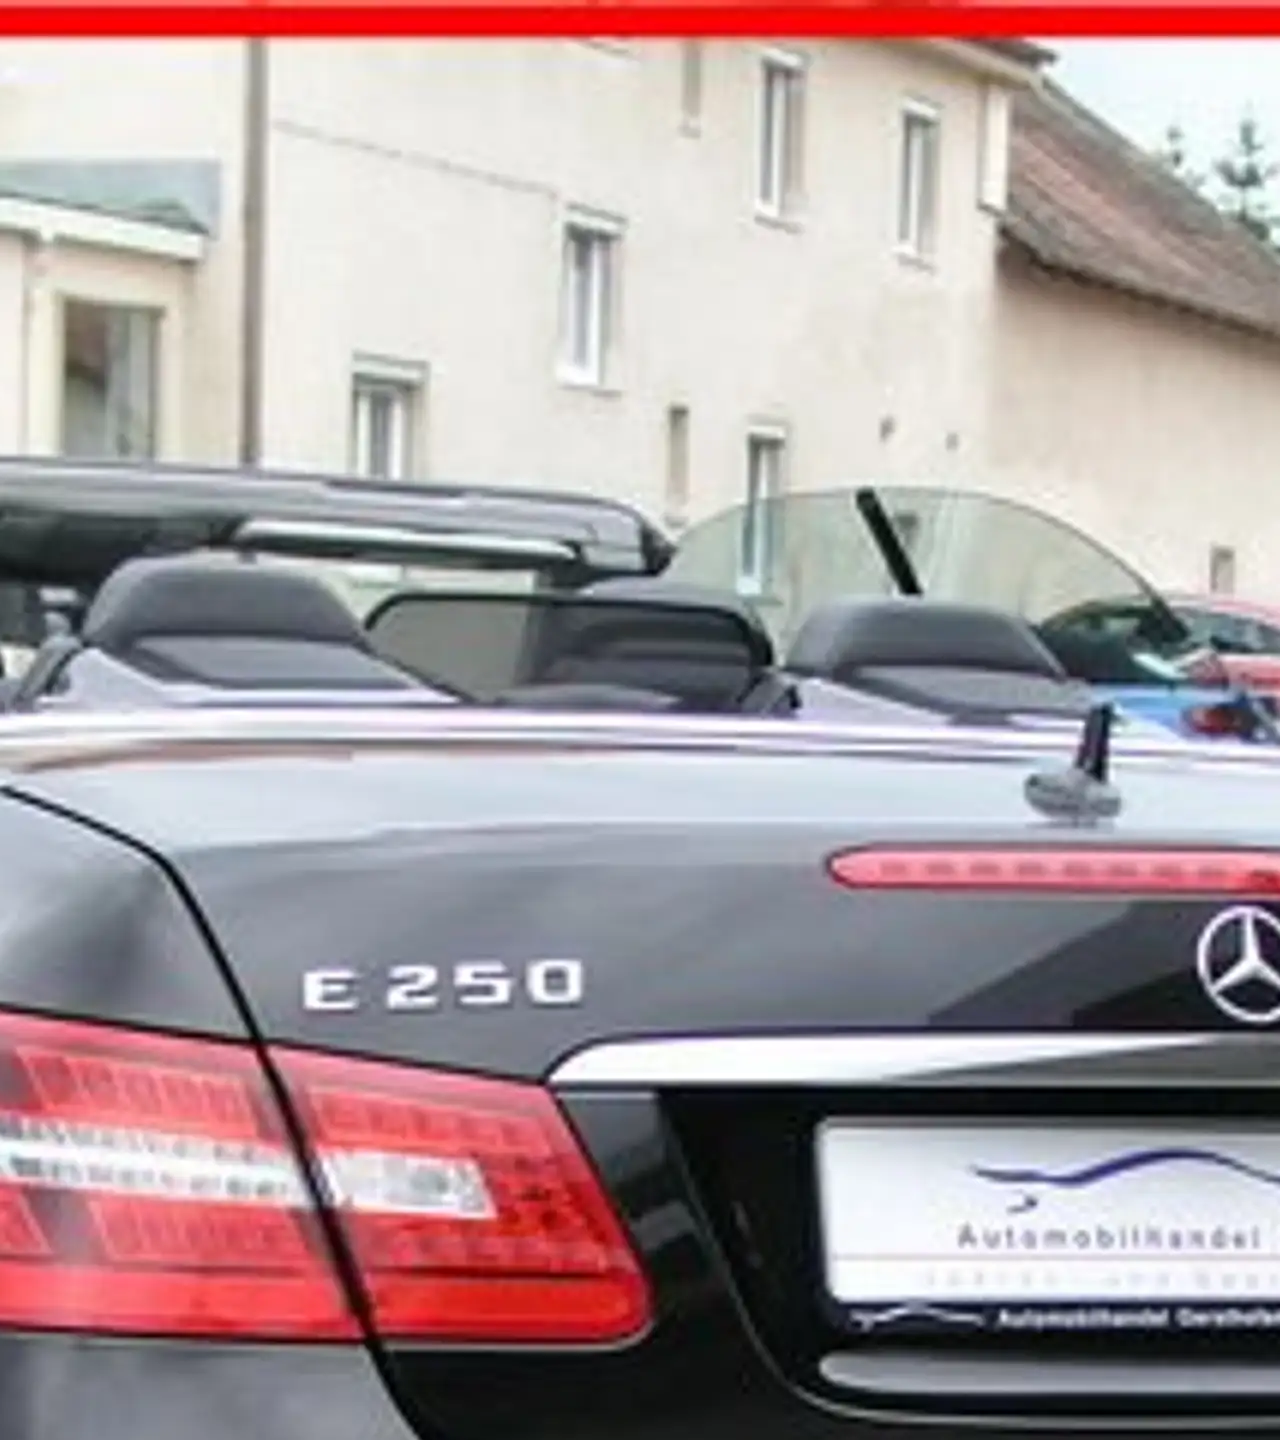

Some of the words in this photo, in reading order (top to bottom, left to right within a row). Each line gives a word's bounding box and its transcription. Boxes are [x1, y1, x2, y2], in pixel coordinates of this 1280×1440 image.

[302, 967, 359, 1011] E
[385, 958, 586, 1009] 250
[956, 1221, 1262, 1250] Automobilhandel
